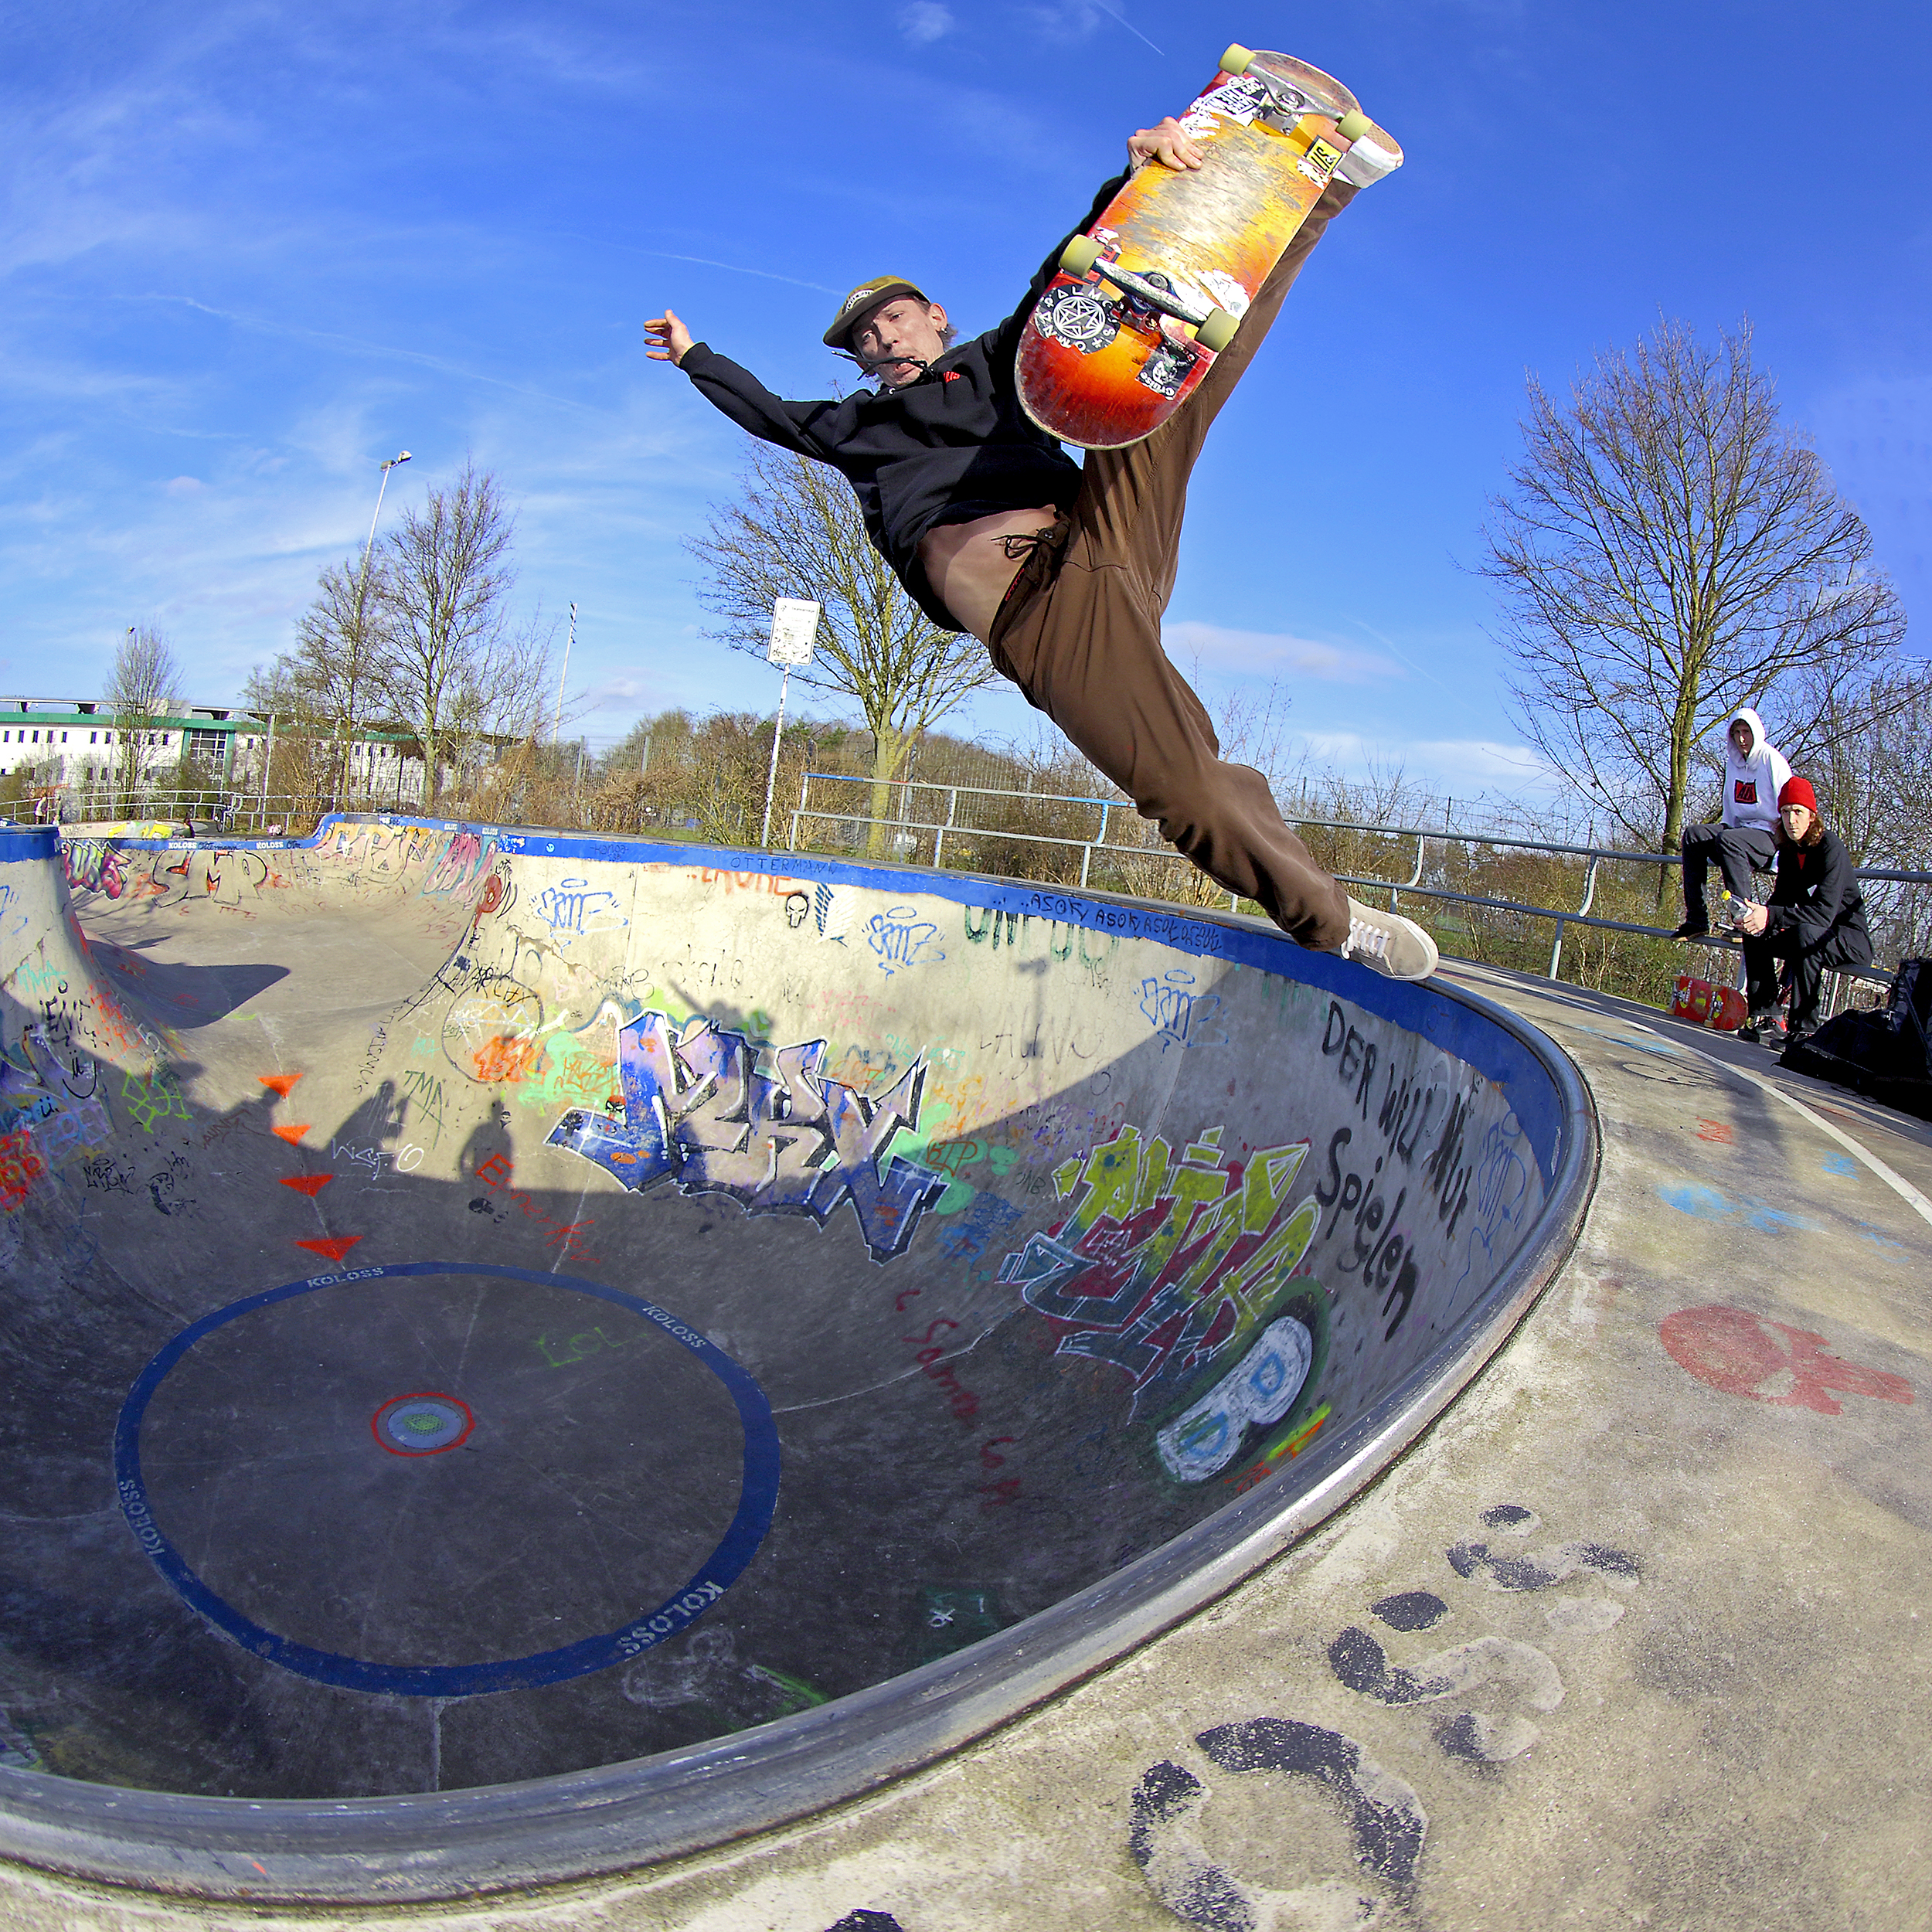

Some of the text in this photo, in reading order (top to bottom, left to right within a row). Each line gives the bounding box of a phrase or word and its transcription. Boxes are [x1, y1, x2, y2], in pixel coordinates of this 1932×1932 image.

[168, 841, 197, 849] KOLOSS
[256, 841, 284, 850] KOLOSS
[730, 856, 839, 875] OTTERMANN
[1322, 1000, 1377, 1122] DER
[307, 1265, 385, 1288] KOLOSS
[641, 1303, 708, 1350] KOLOSS
[118, 1478, 166, 1555] KOLOSS
[616, 1579, 726, 1656] KOLOSS
